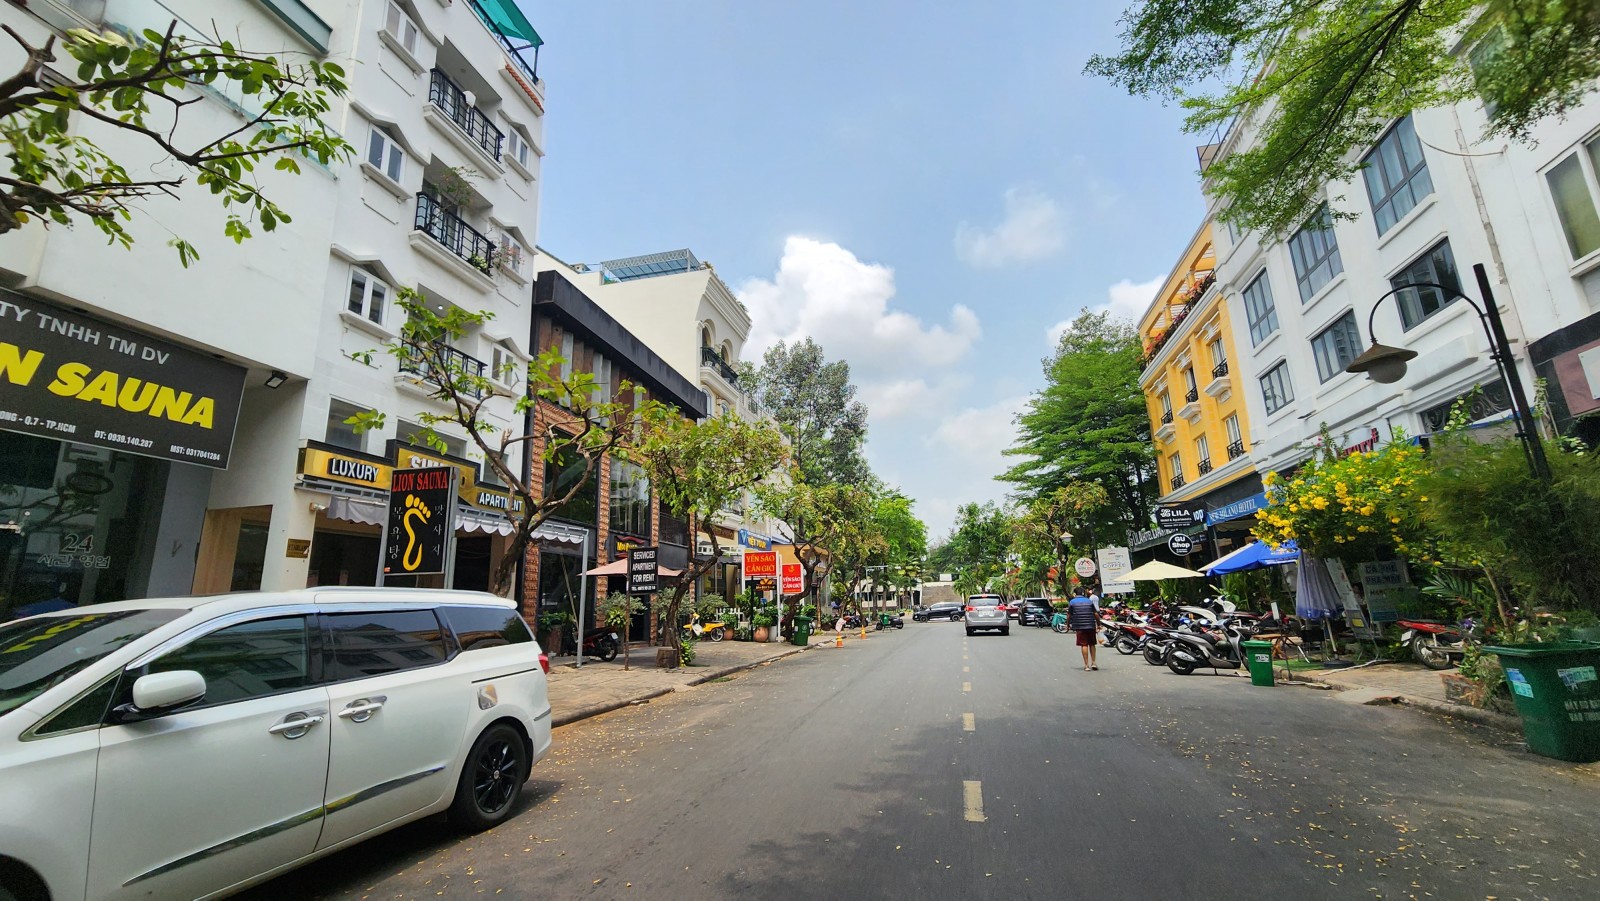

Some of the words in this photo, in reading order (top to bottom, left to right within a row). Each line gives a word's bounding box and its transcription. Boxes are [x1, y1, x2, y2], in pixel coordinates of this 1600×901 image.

[0, 301, 31, 322] TY
[37, 313, 100, 345] TNHH
[107, 335, 137, 356] TM
[141, 346, 170, 365] DV
[47, 362, 214, 429] SAUNA
[25, 416, 38, 426] Q.7
[46, 420, 76, 433] TP.HCM
[170, 445, 185, 454] MST:
[331, 458, 379, 482] LUXURY
[392, 473, 415, 492] LION
[416, 471, 448, 491] SAUNA
[1171, 509, 1190, 517] LILA
[1238, 498, 1256, 513] HOTEL
[61, 533, 94, 553] 24
[633, 551, 655, 560] SERVICED
[632, 562, 656, 571] APARTMENT
[633, 574, 642, 583] FOR
[643, 573, 655, 582] RENT
